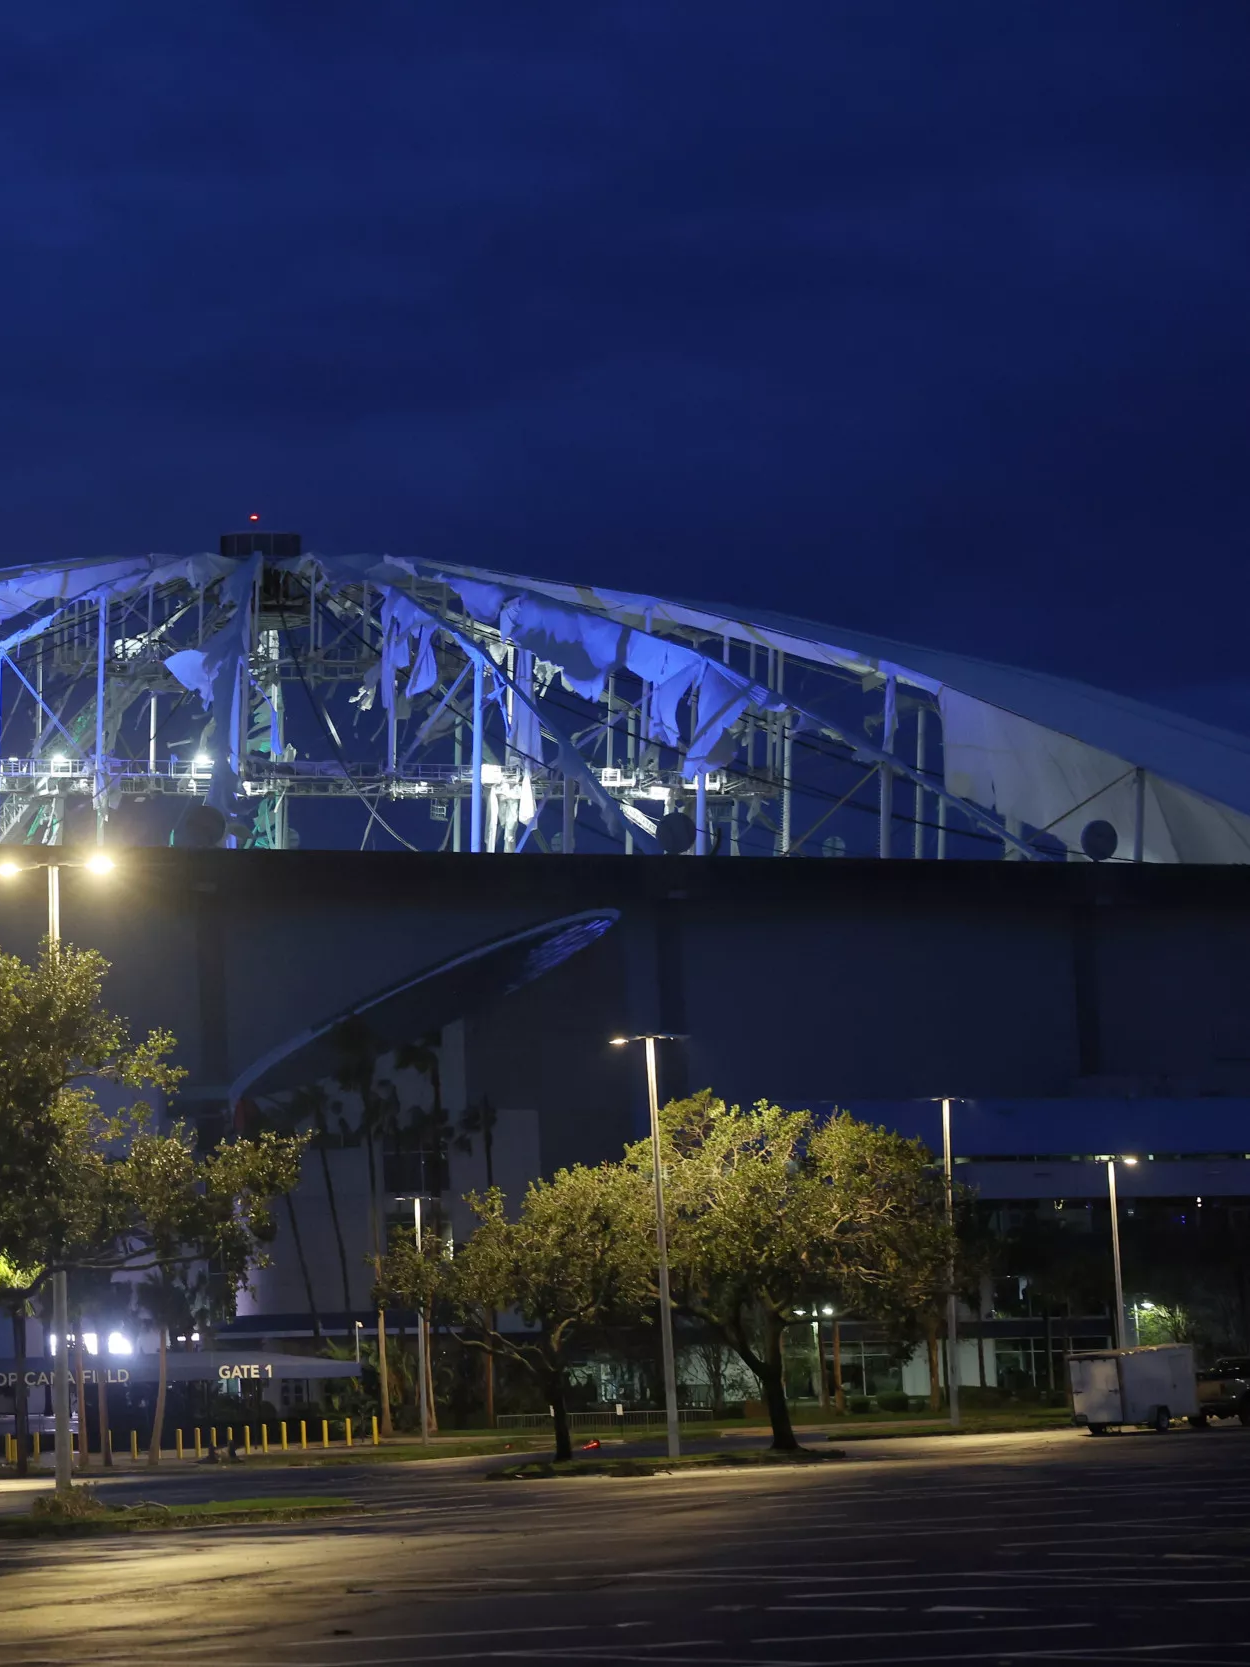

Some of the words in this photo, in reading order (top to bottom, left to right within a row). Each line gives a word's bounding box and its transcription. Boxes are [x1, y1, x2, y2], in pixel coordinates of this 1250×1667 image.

[81, 1368, 130, 1385] FILD
[218, 1364, 260, 1379] GATE
[264, 1364, 273, 1379] 1
